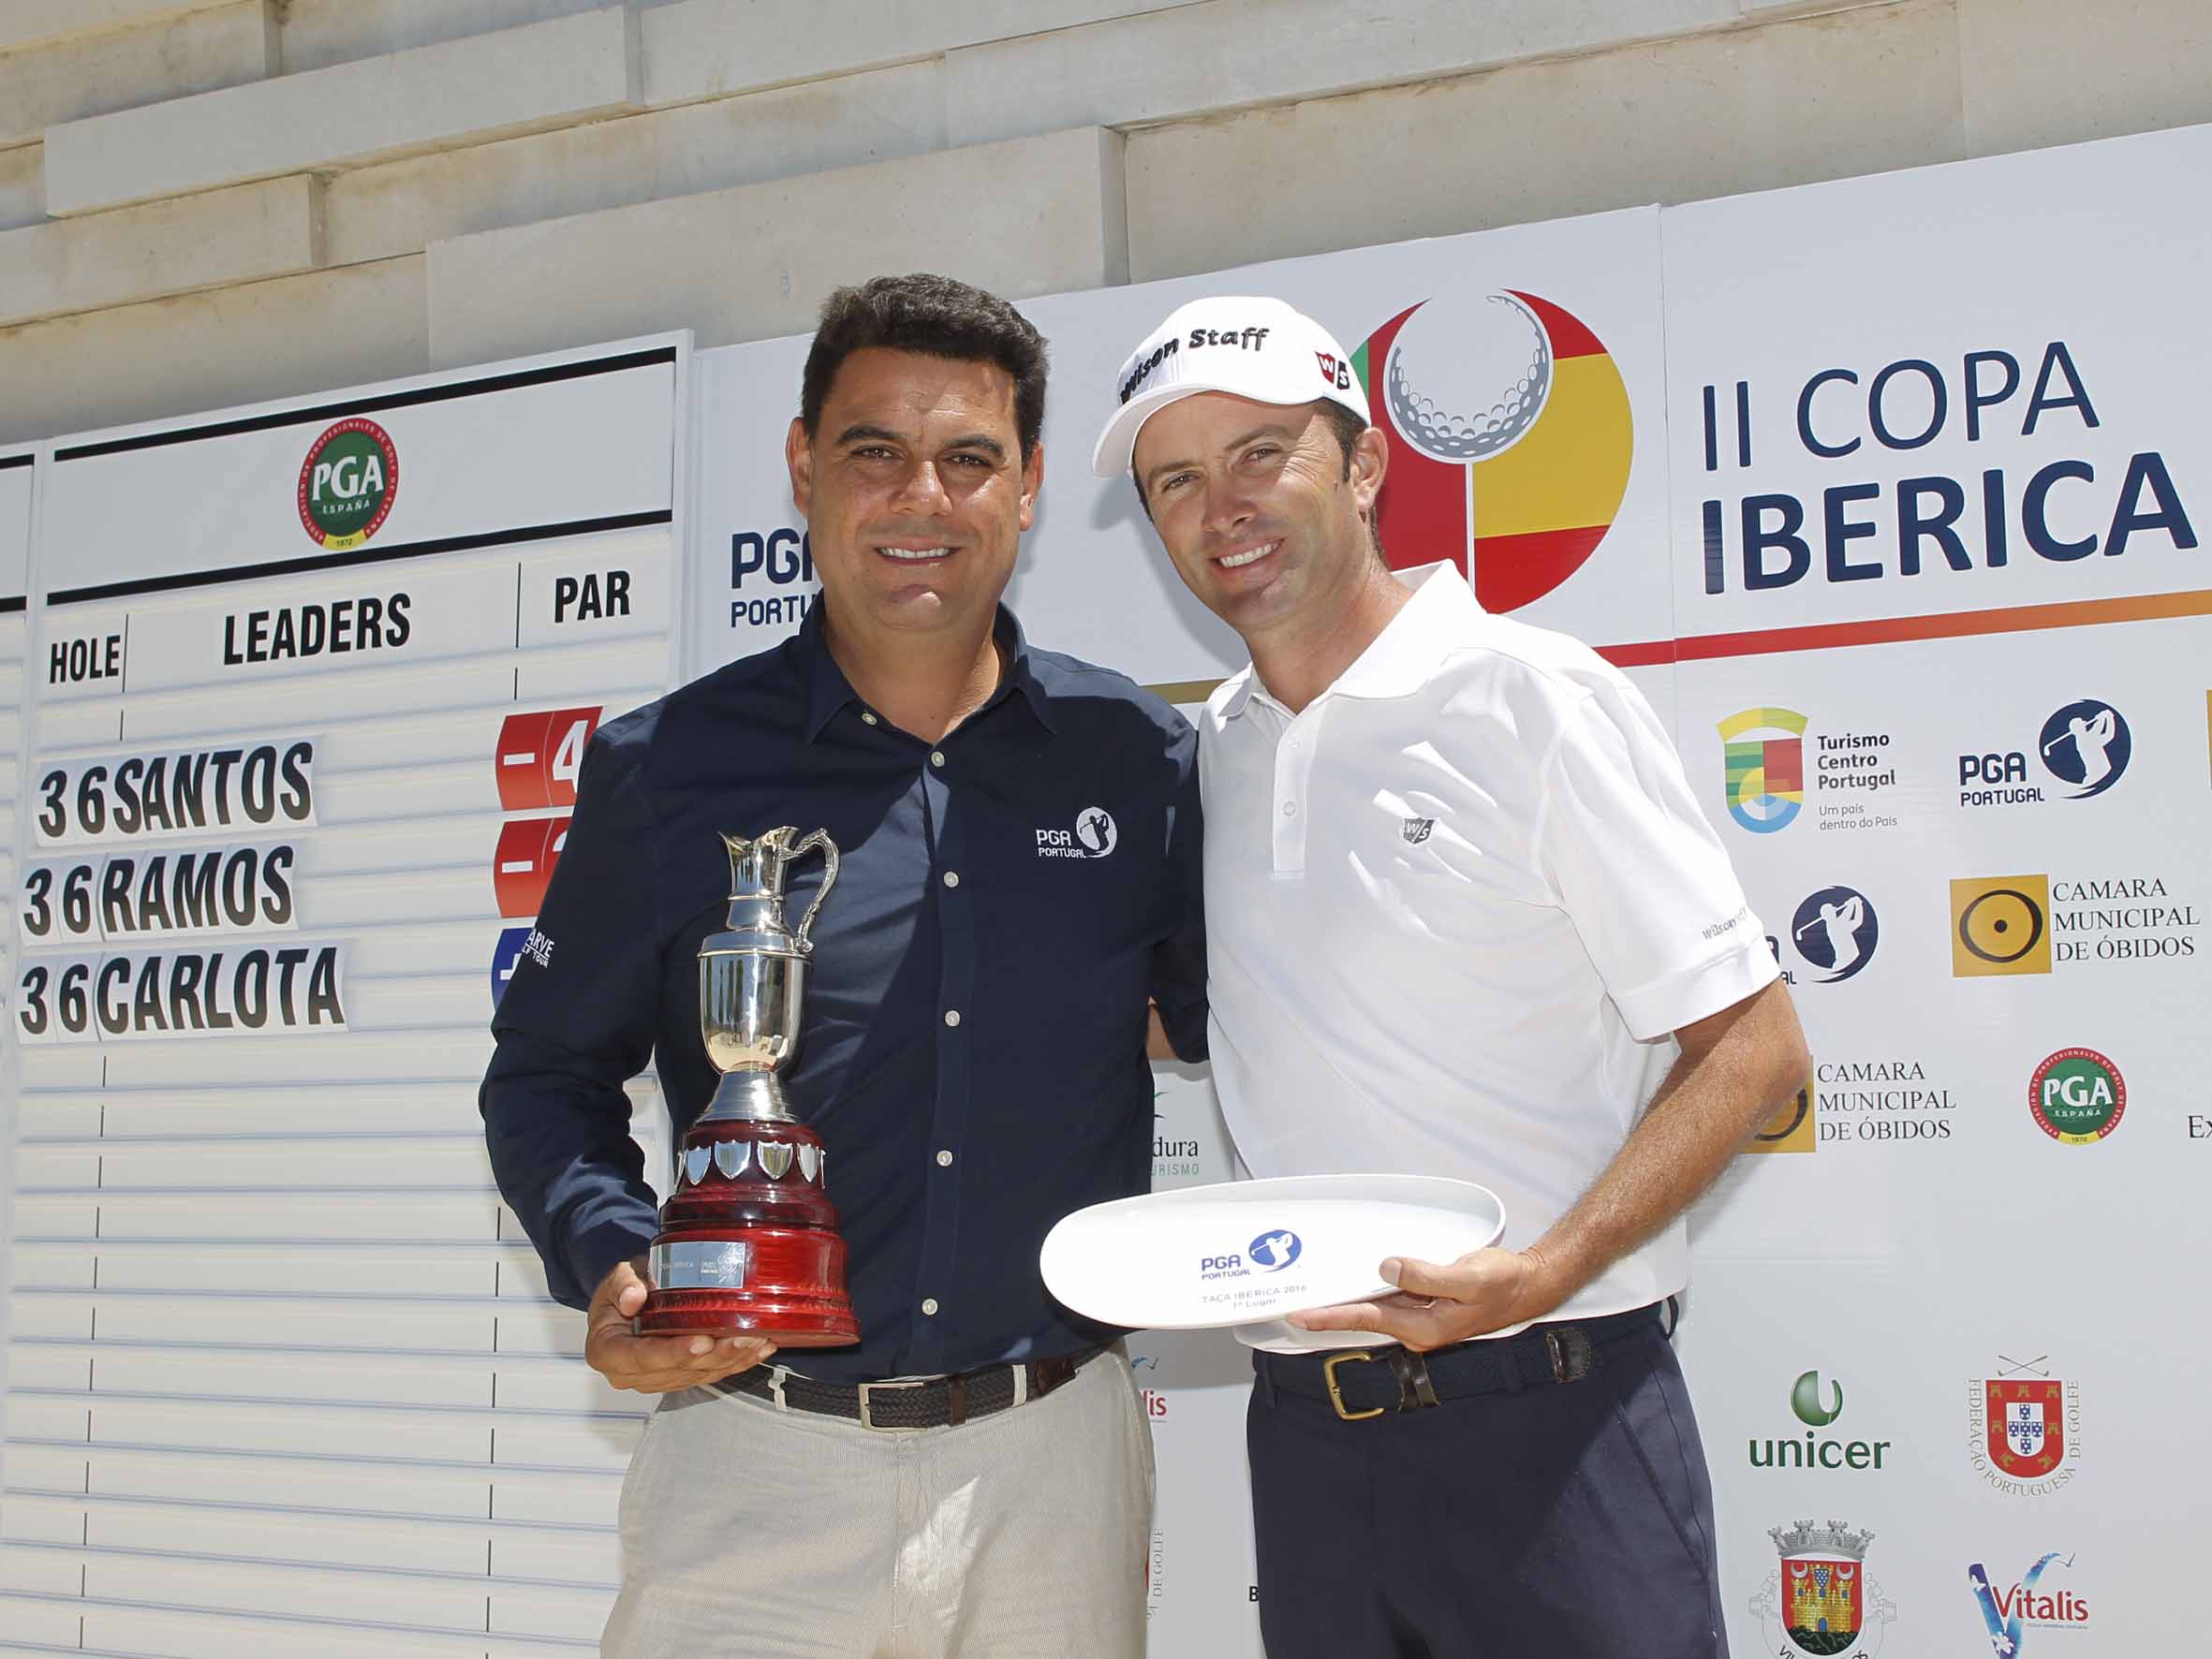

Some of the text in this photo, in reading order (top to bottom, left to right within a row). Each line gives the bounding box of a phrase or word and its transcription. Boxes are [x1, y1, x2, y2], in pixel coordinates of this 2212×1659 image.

[1188, 327, 1269, 351] Staff
[1703, 341, 2101, 471] II COPA
[312, 455, 384, 501] PGA
[323, 499, 370, 514] ESPAÑA
[1703, 451, 2199, 595] IBERICA
[50, 570, 631, 683] HOLE LEADERS PAR
[1817, 733, 1890, 750] Turismo
[1818, 754, 1878, 770] Centro
[1959, 752, 2027, 785] PGA
[112, 741, 314, 835] SANTOS
[1819, 770, 1896, 790] Portugal
[1961, 787, 2045, 807] PORTUGAL
[1819, 805, 1838, 815] Um
[1820, 819, 1857, 830] dentro
[1859, 817, 1873, 828] do
[1036, 830, 1071, 846] PGA
[1038, 847, 1087, 859] PORTUGAL
[102, 845, 293, 932] RAMOS
[2053, 878, 2168, 902] CAMARA
[2054, 906, 2200, 932] MUNICIPAL
[2055, 934, 2195, 962] DE ÓBIDOS
[96, 947, 347, 1035] CARLOTA
[1818, 1062, 1925, 1082] CAMARA
[1819, 1090, 1957, 1111] MUNICIPAL
[2044, 1076, 2114, 1107] PGA
[2055, 1108, 2101, 1117] ESPAÑA
[1820, 1116, 1951, 1140] DE ÓBIDOS
[1202, 1254, 1241, 1272] PGA
[1202, 1269, 1251, 1281] PORTUGAL
[1749, 1431, 1891, 1469] unicer
[1969, 1380, 2081, 1497] FEDERAÇÃO PORTUGUESA DE GOLFE
[1992, 1582, 2089, 1622] Vitalis
